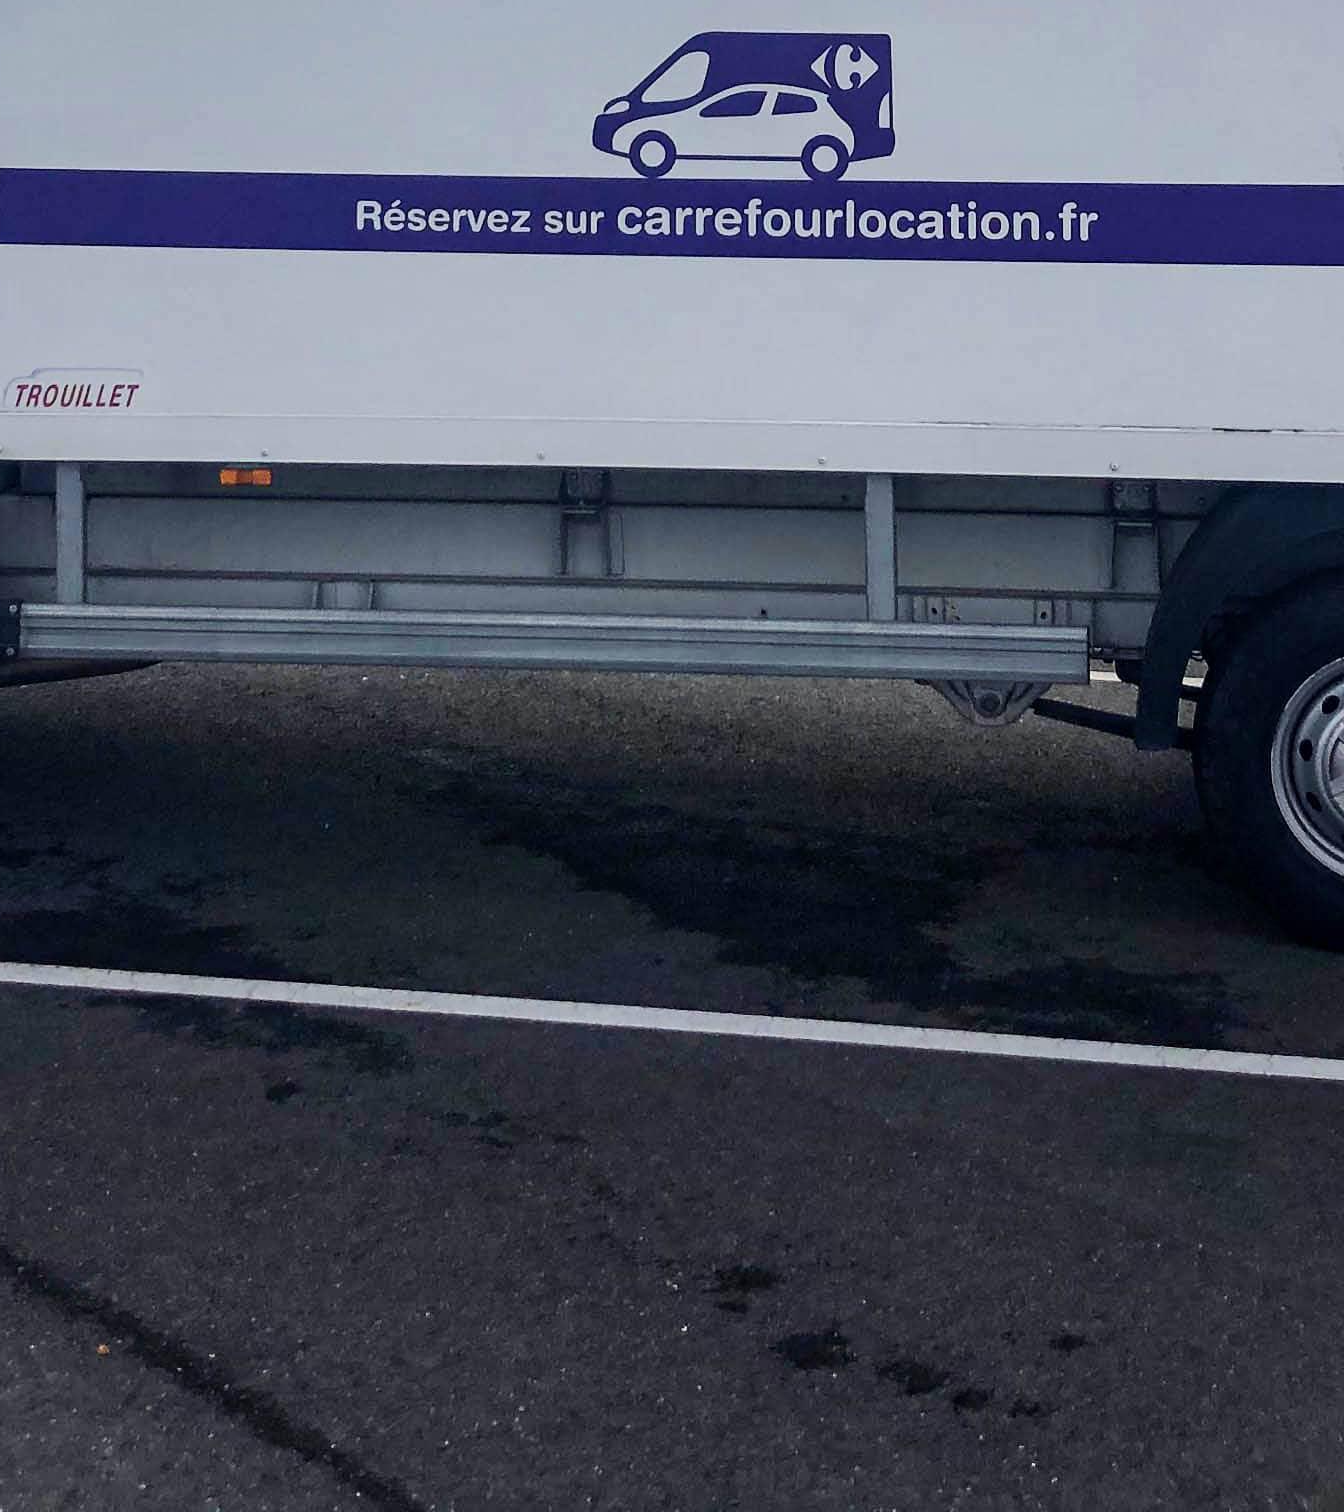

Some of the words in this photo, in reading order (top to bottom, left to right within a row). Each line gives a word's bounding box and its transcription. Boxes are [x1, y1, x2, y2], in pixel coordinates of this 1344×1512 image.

[356, 199, 531, 233] Réservez
[544, 209, 605, 235] sur
[616, 198, 1099, 242] carrefourlocation.fr
[15, 384, 140, 408] TROUILLET
